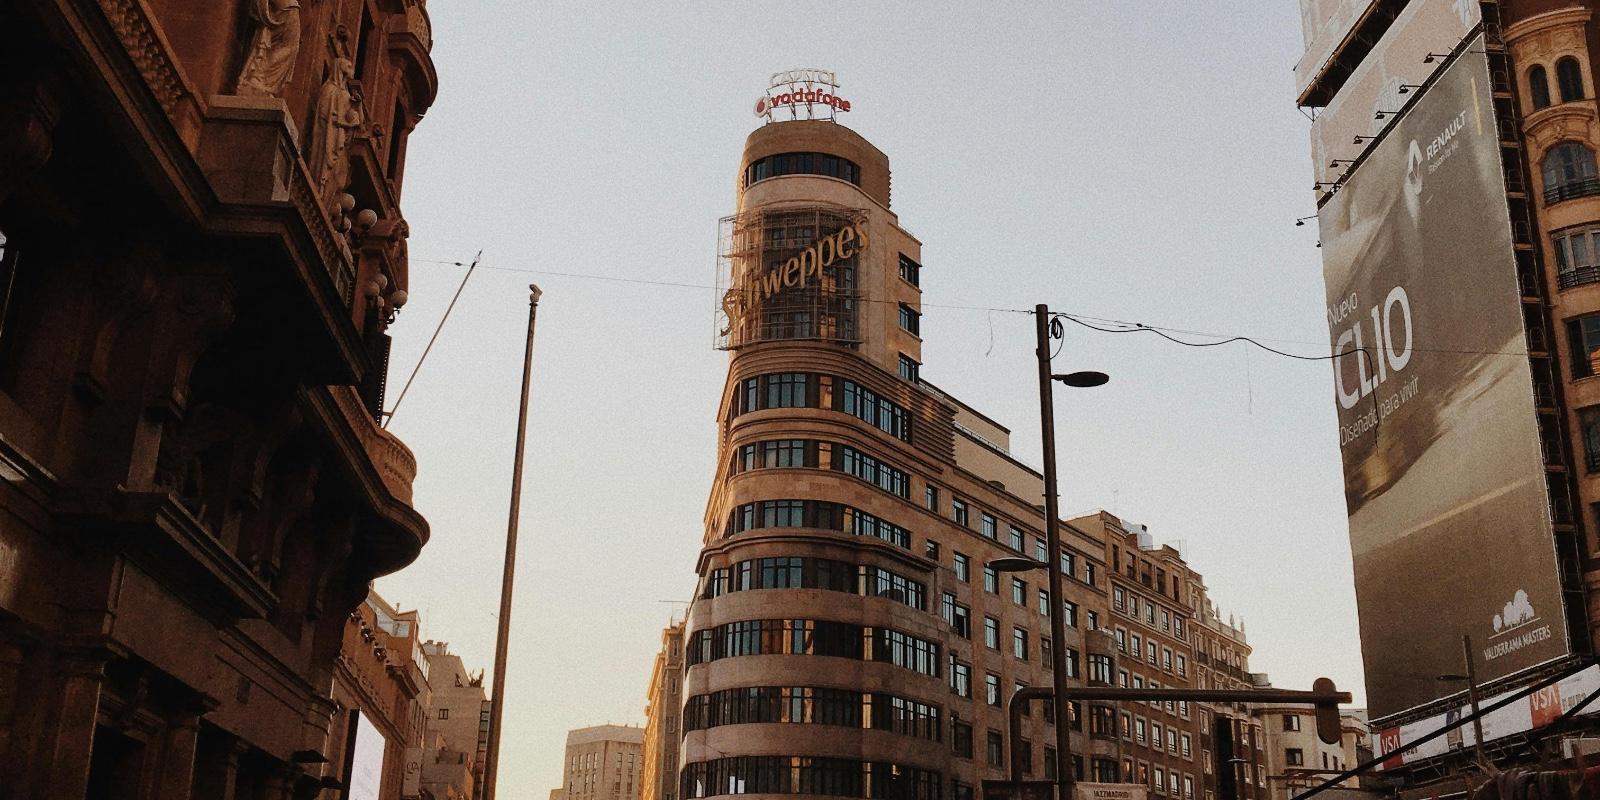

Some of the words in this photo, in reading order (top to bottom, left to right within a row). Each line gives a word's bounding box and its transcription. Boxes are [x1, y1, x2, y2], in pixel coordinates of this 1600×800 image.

[770, 87, 851, 113] vodafone
[1426, 110, 1466, 160] RENAULT
[1327, 292, 1358, 329] Nuevo
[1335, 286, 1413, 410] CLIO
[1379, 393, 1400, 424] para
[1400, 375, 1419, 403] vivir
[1483, 637, 1522, 661] VALDERRAMA
[1522, 624, 1552, 647] MASTERS
[1381, 734, 1400, 756] VSA
